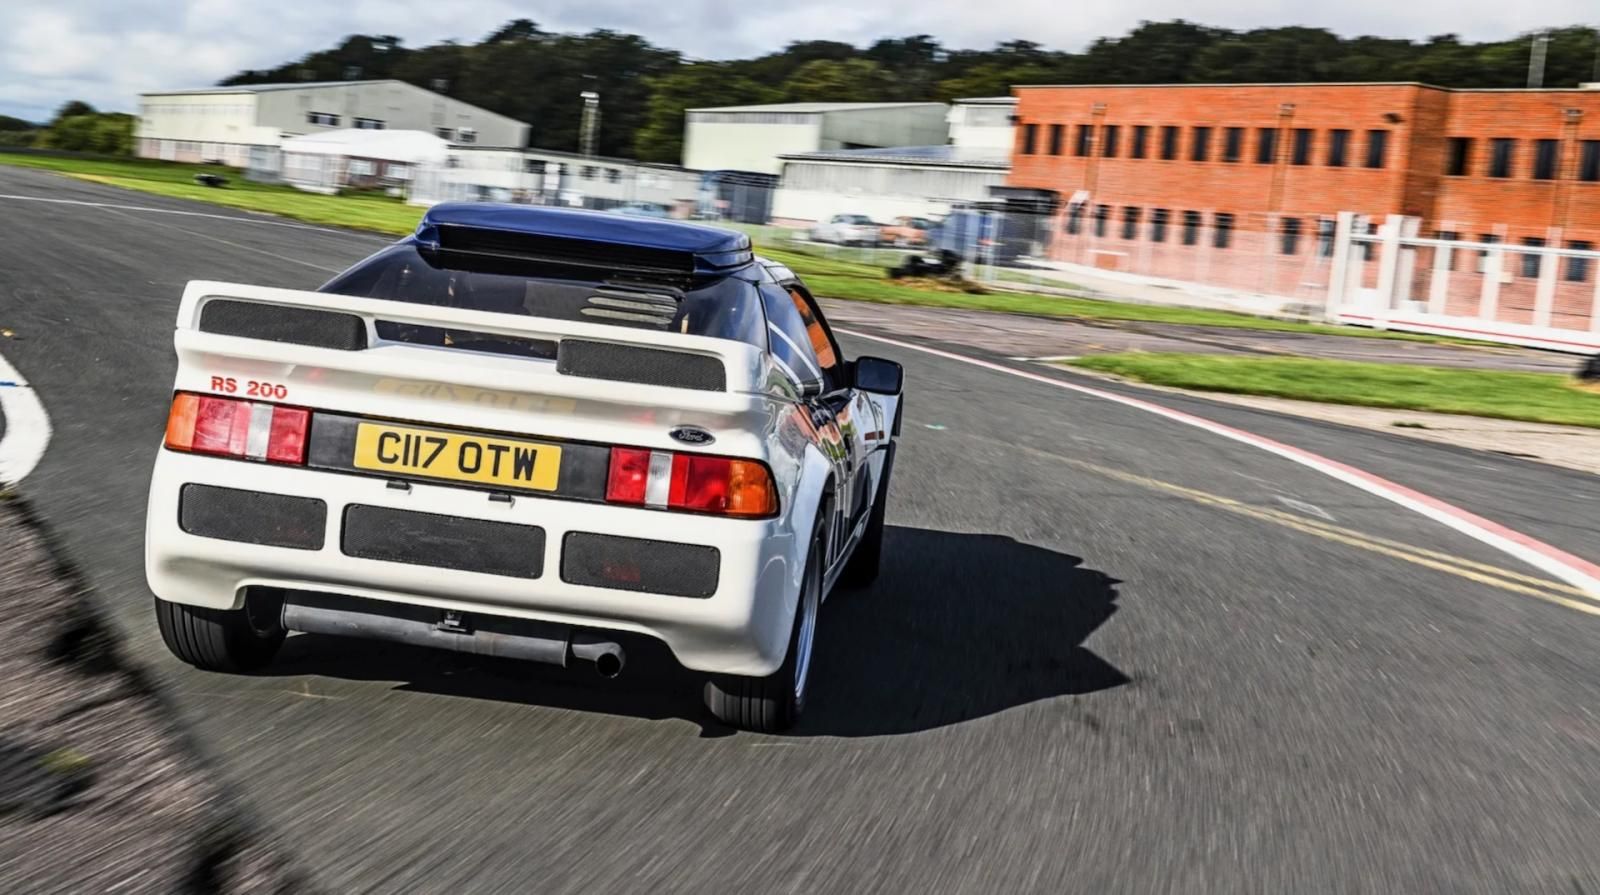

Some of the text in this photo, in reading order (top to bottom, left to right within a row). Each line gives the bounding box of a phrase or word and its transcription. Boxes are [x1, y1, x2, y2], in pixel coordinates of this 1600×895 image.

[211, 375, 288, 400] RS 200
[678, 428, 704, 442] Ford
[377, 431, 538, 482] C117 OTW
